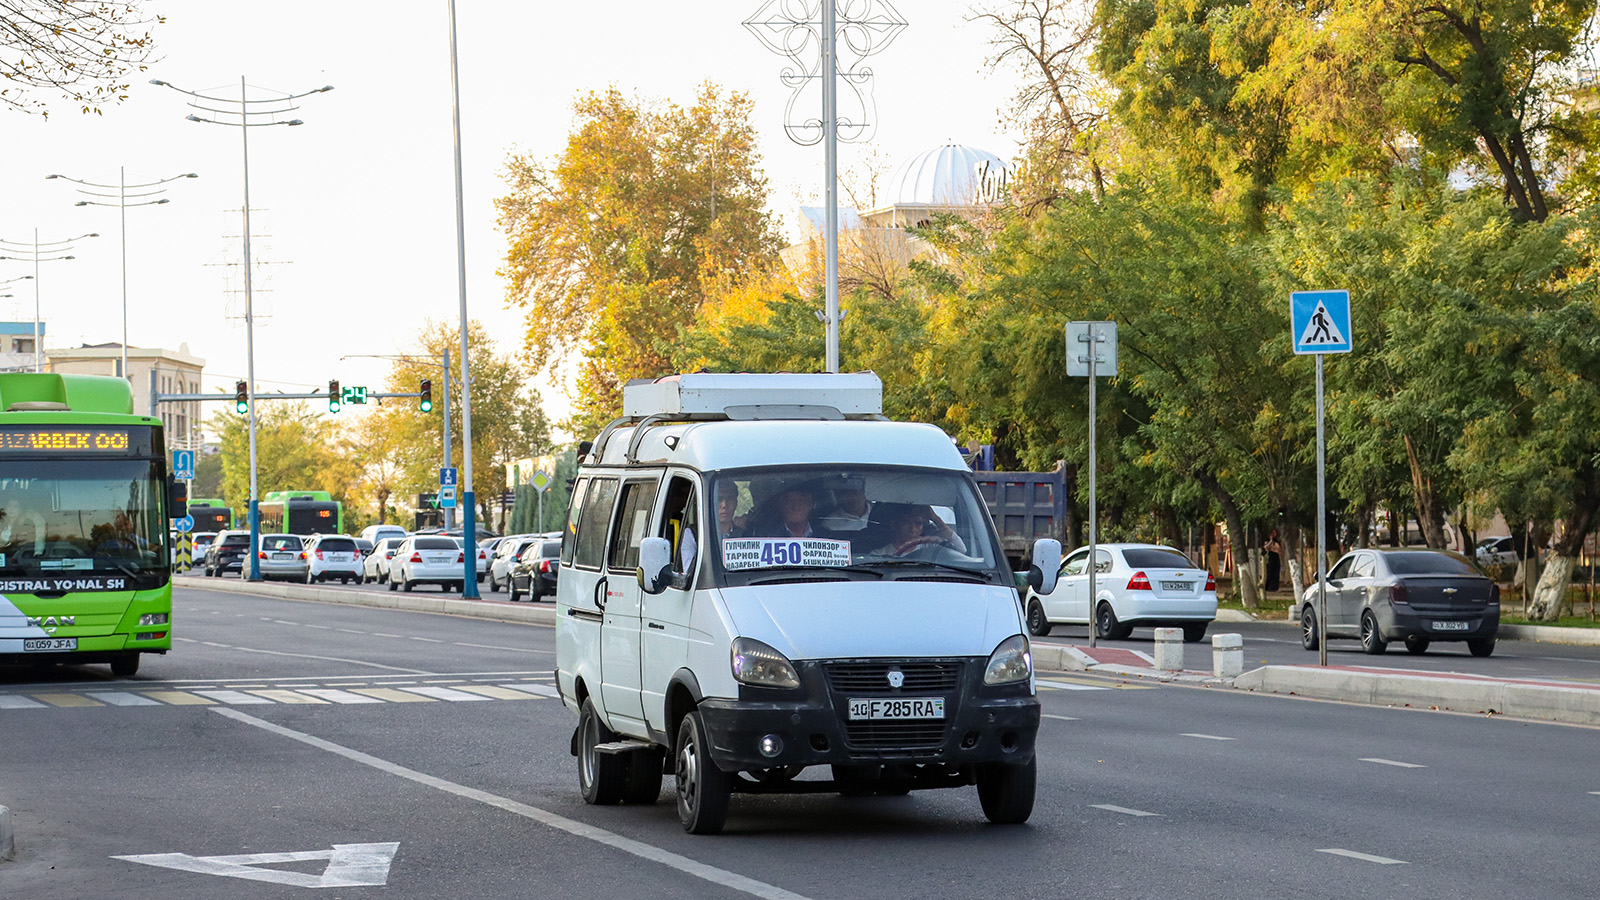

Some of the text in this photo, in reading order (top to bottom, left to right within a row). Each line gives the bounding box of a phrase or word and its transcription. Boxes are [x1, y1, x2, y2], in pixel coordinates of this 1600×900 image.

[343, 386, 366, 404] 24
[803, 541, 840, 551] ЧИЛОНЗОР
[726, 552, 760, 561] ТАРНОВ
[761, 542, 802, 565] 450
[803, 551, 833, 559] ФАРХОД
[726, 561, 760, 570] НАЗАРБЕК
[107, 579, 125, 588] SH
[27, 616, 75, 626] MAN
[854, 704, 867, 716] 10
